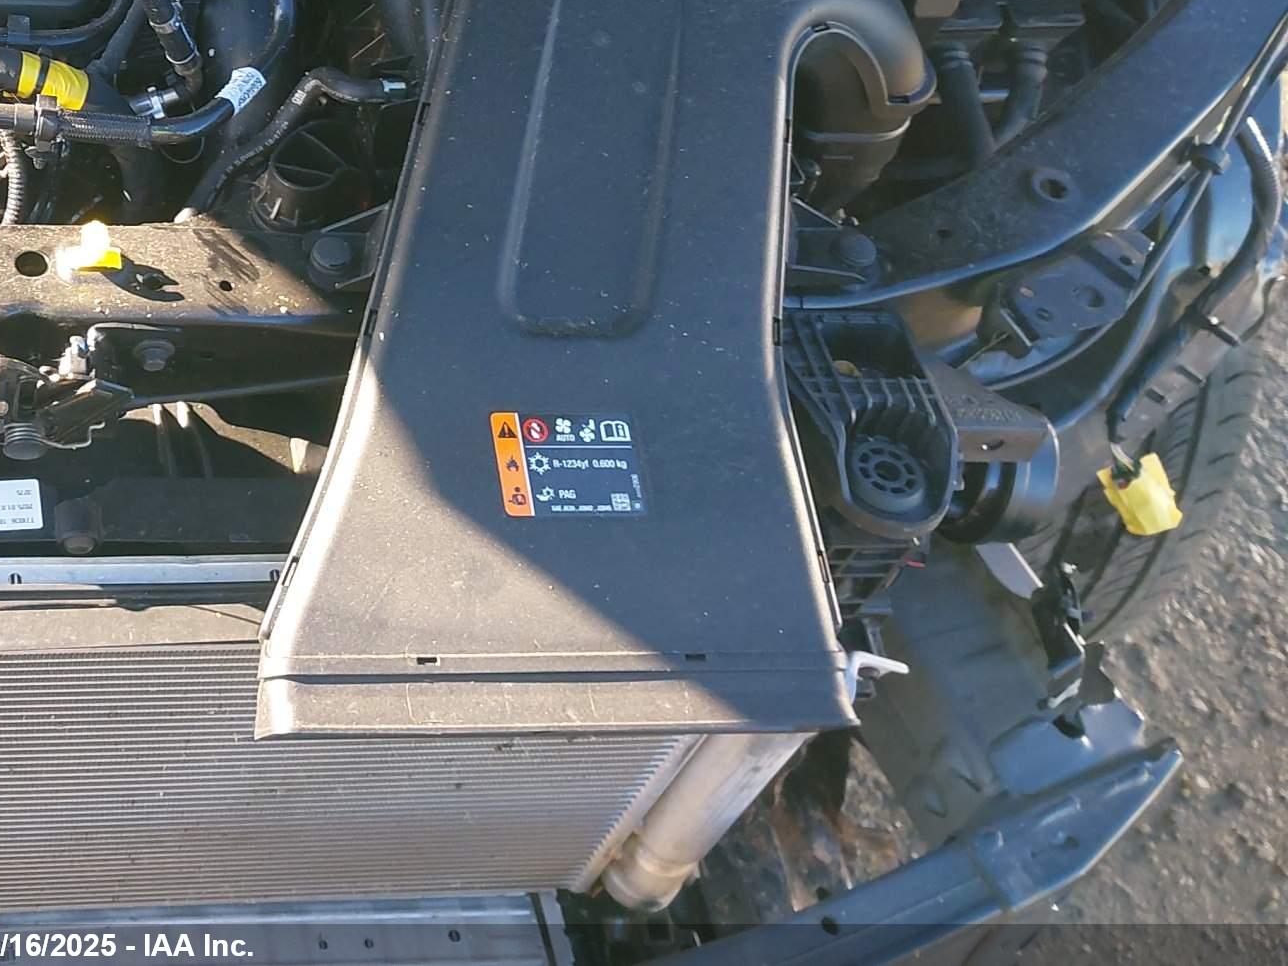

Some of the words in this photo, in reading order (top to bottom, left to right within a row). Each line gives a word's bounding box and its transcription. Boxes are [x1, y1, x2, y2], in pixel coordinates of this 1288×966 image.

[556, 434, 576, 442] AUTO
[616, 459, 628, 470] kg
[559, 489, 576, 499] PAG
